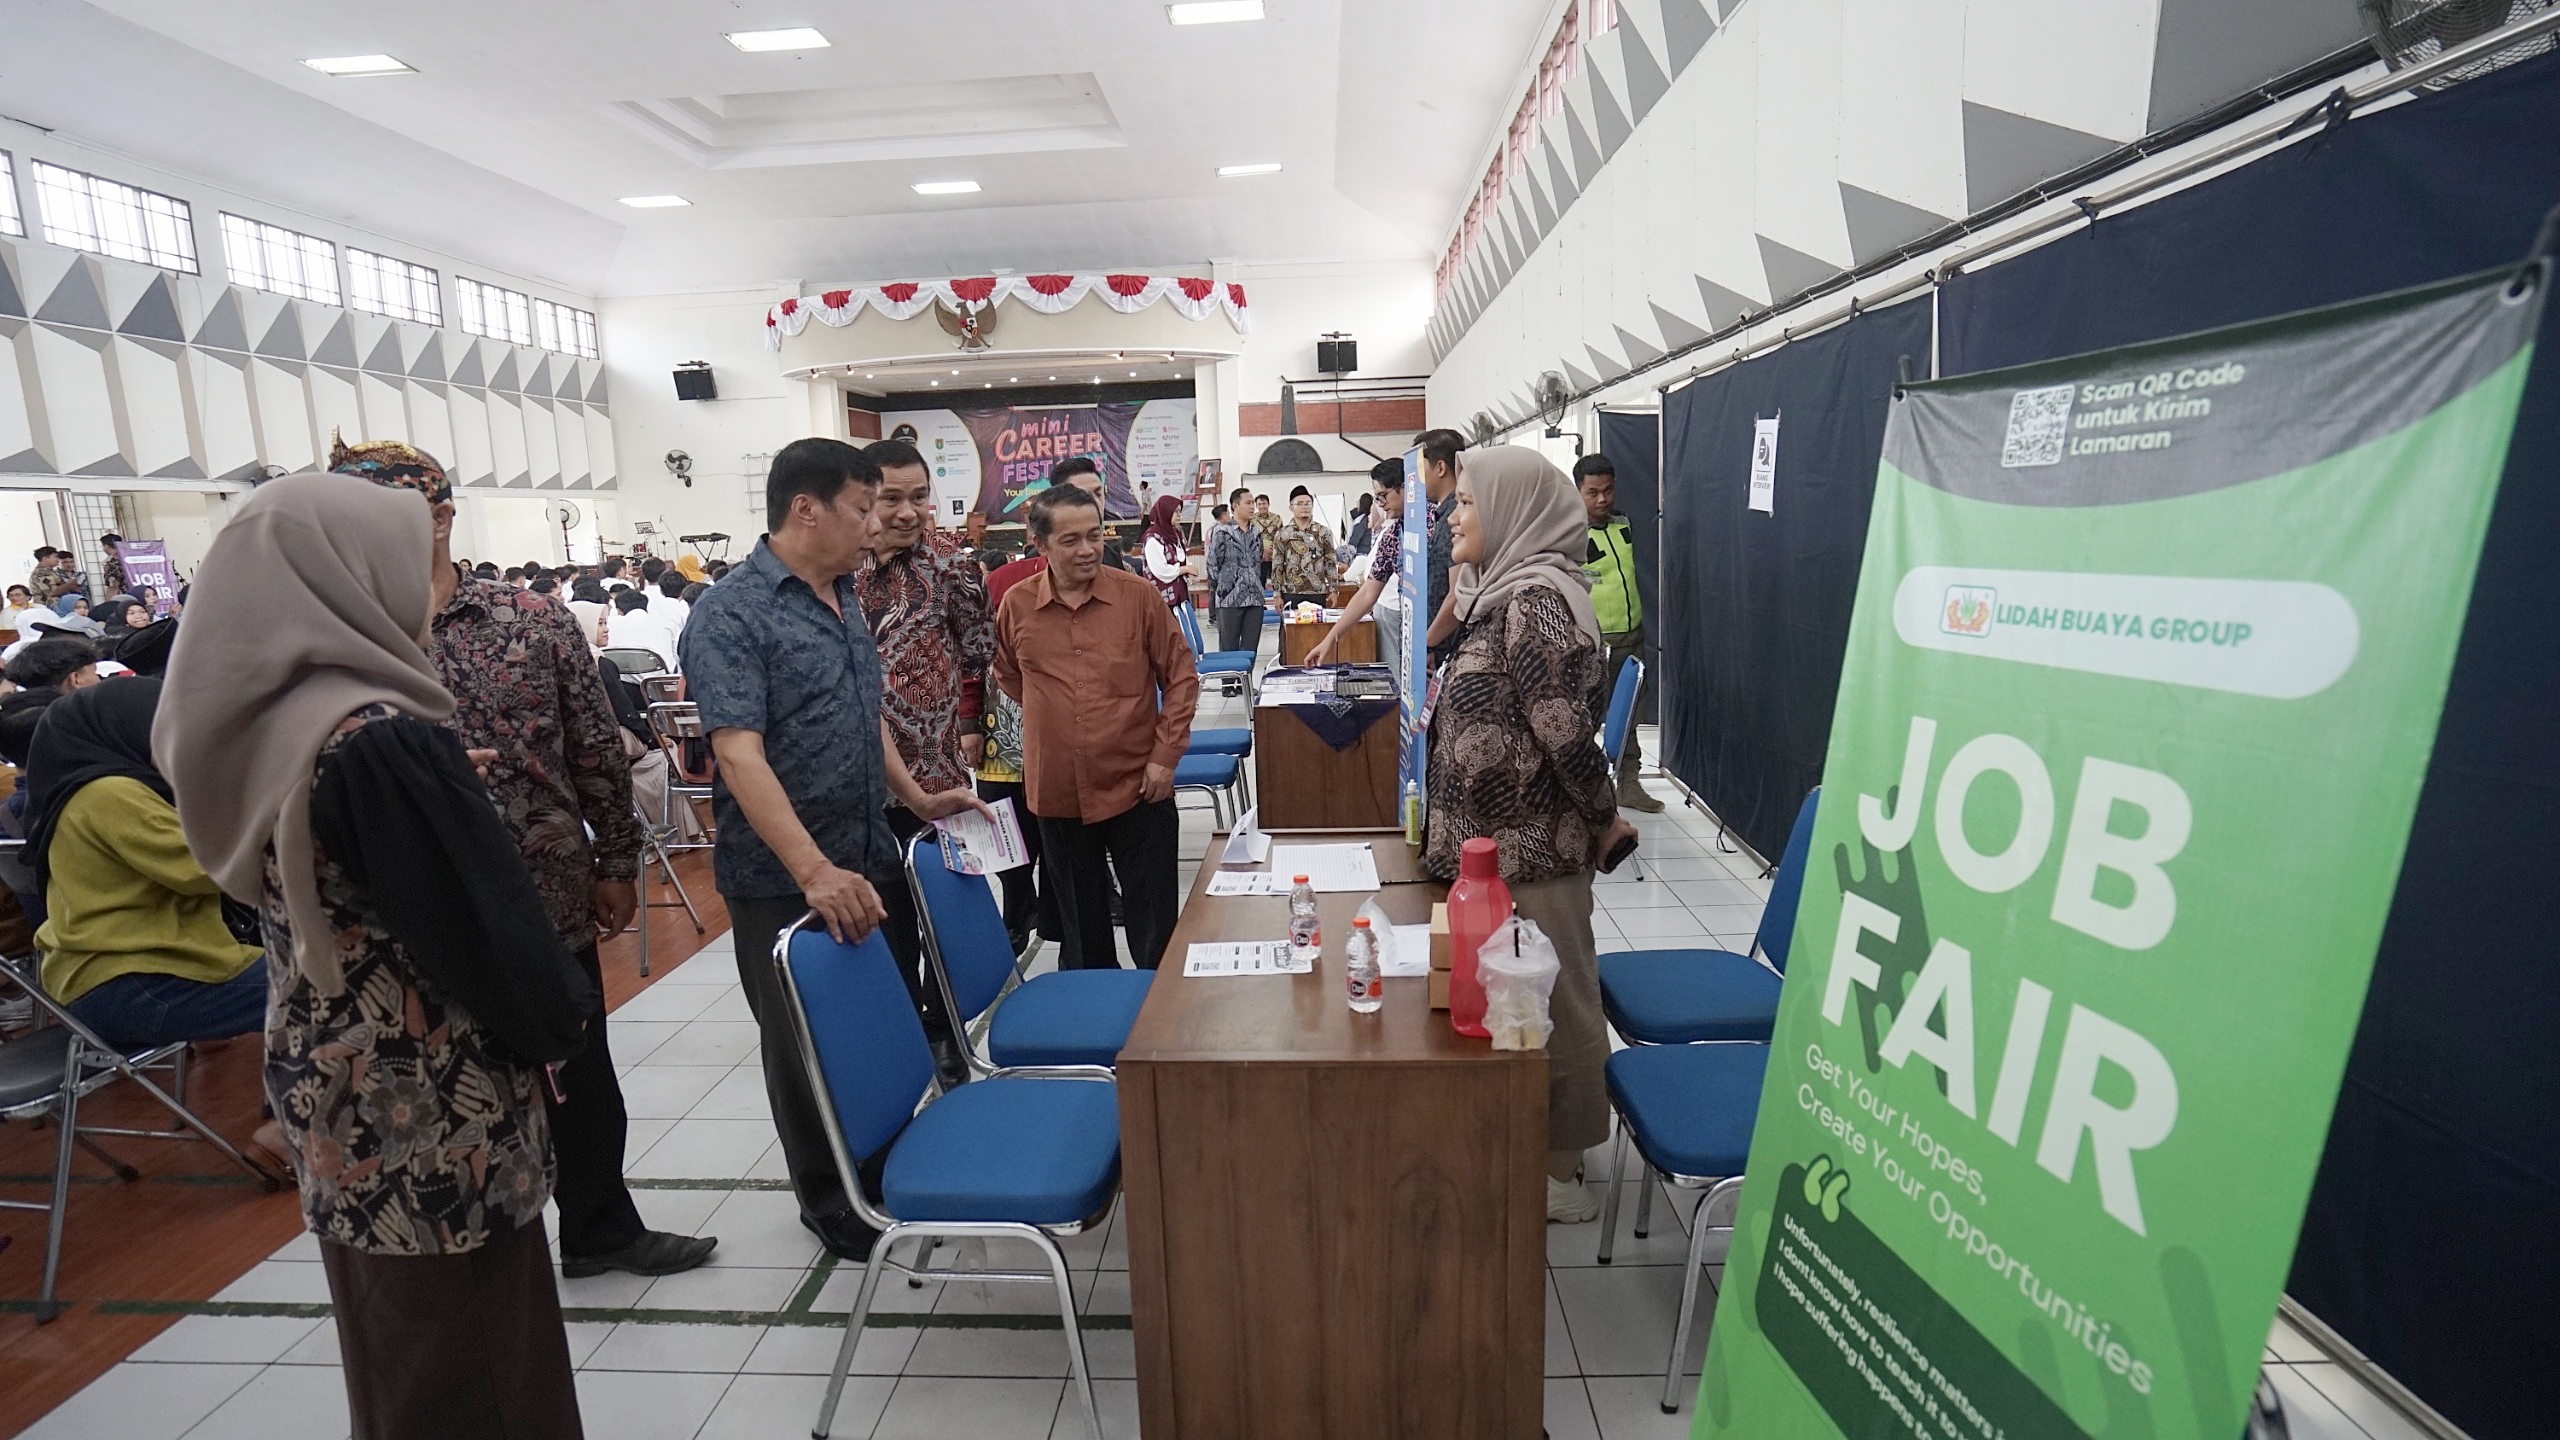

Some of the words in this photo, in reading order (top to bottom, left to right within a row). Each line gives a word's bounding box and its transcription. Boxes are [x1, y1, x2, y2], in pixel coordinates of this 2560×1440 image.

[2080, 382, 2135, 404] Scan
[2138, 371, 2173, 397] QR
[2176, 361, 2245, 390] Code
[1021, 413, 1070, 437] mini
[2075, 402, 2138, 429] untuk
[2143, 396, 2211, 423] Kirim
[995, 429, 1102, 462] CAREER
[2069, 430, 2172, 456] Lamaran
[1003, 460, 1053, 484] FEST
[131, 572, 166, 587] JOB
[156, 586, 174, 600] IR
[1996, 603, 2058, 629] LIDAH
[2061, 609, 2144, 639] BUAYA
[2150, 617, 2253, 648] GROUP
[1858, 715, 2193, 951] JOB
[1821, 889, 2180, 1238] FAIR
[1805, 1043, 1843, 1089] Get
[1848, 1070, 1898, 1127] Your
[1899, 1111, 1988, 1206] Hopes,
[1797, 1082, 1867, 1156] Create
[1872, 1138, 1926, 1201] Your
[1928, 1189, 2154, 1395] Opportunities
[1773, 1261, 1780, 1276] I
[1777, 1264, 1806, 1305] hope
[1803, 1298, 1857, 1368] suffering
[1855, 1353, 1916, 1430] happens
[1778, 1237, 1785, 1252] I
[1809, 1269, 1842, 1313] know
[1840, 1303, 1870, 1343] how
[1869, 1335, 1885, 1360] to
[1884, 1352, 1926, 1406] teach
[1925, 1393, 1940, 1420] it
[1939, 1411, 1957, 1439] to
[1784, 1212, 1863, 1307] Unfortunately,
[1863, 1297, 1930, 1373] resilience
[1928, 1365, 1993, 1440] matters
